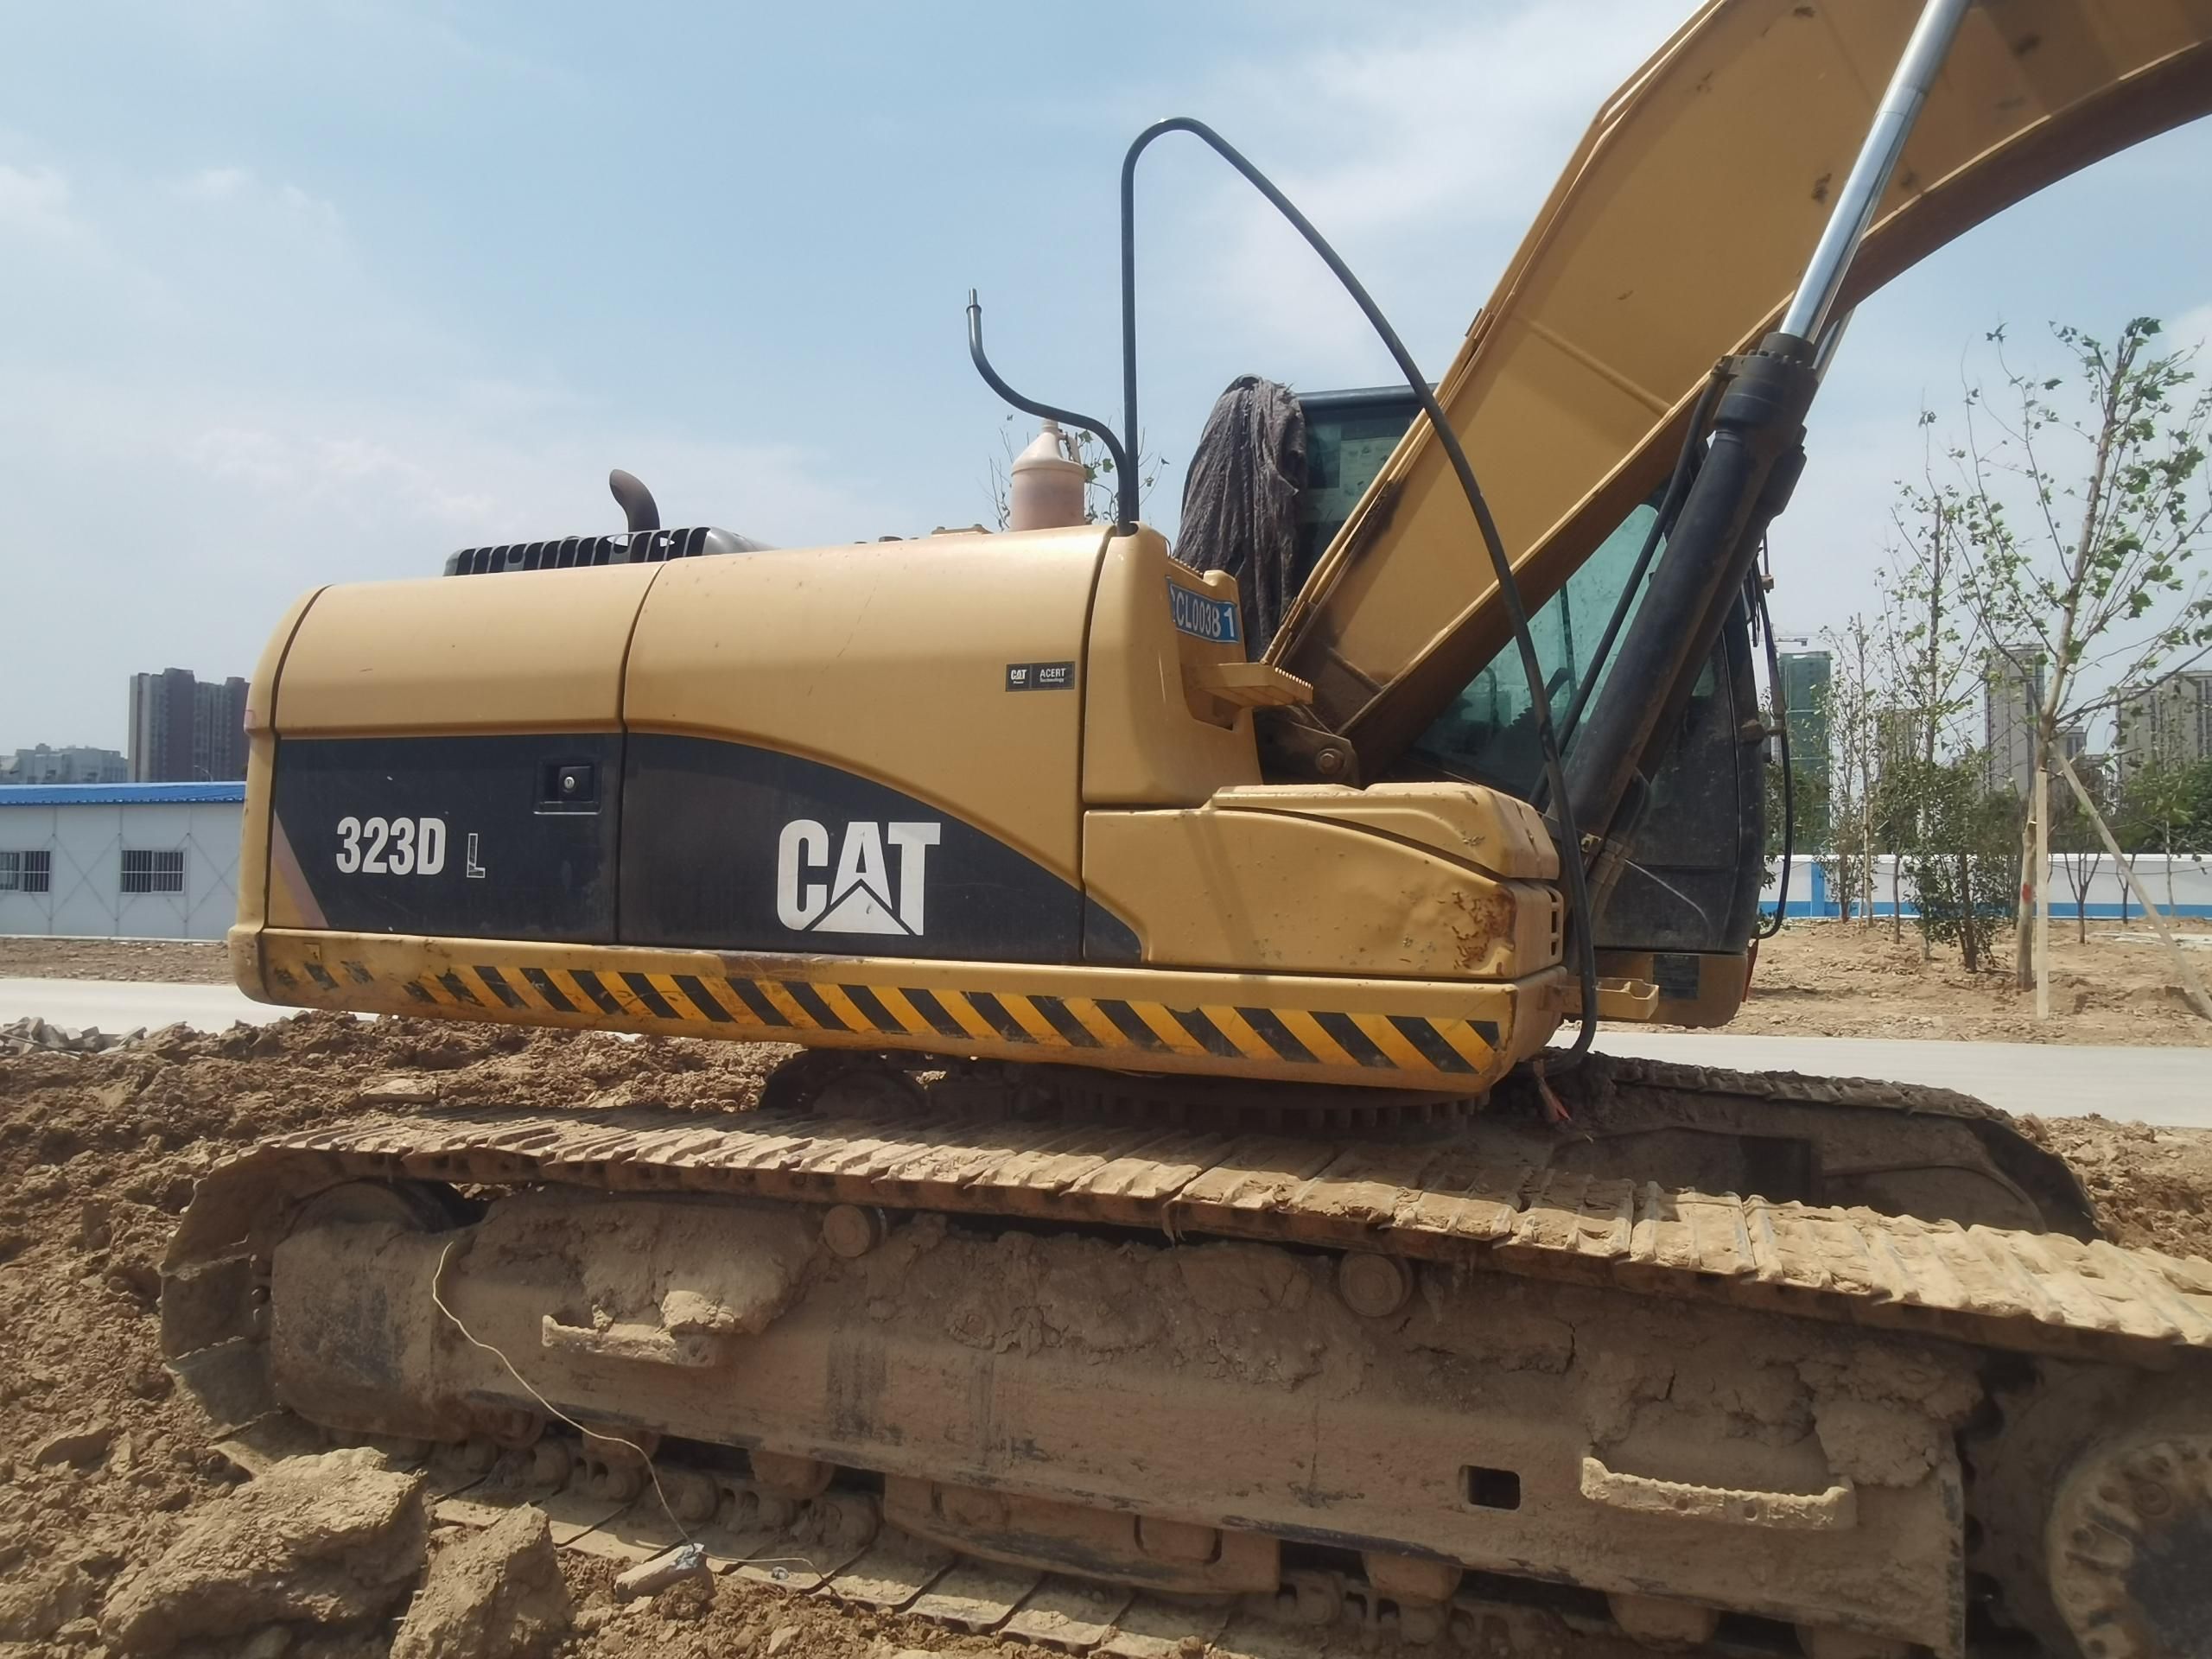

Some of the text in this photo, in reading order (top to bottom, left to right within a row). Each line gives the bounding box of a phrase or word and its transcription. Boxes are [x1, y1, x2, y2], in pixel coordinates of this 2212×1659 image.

[1171, 588, 1235, 638] CL00381
[1010, 669, 1027, 681] CAT
[1039, 667, 1066, 678] ACERT
[336, 817, 486, 878] 323D L
[777, 819, 941, 936] CAT
